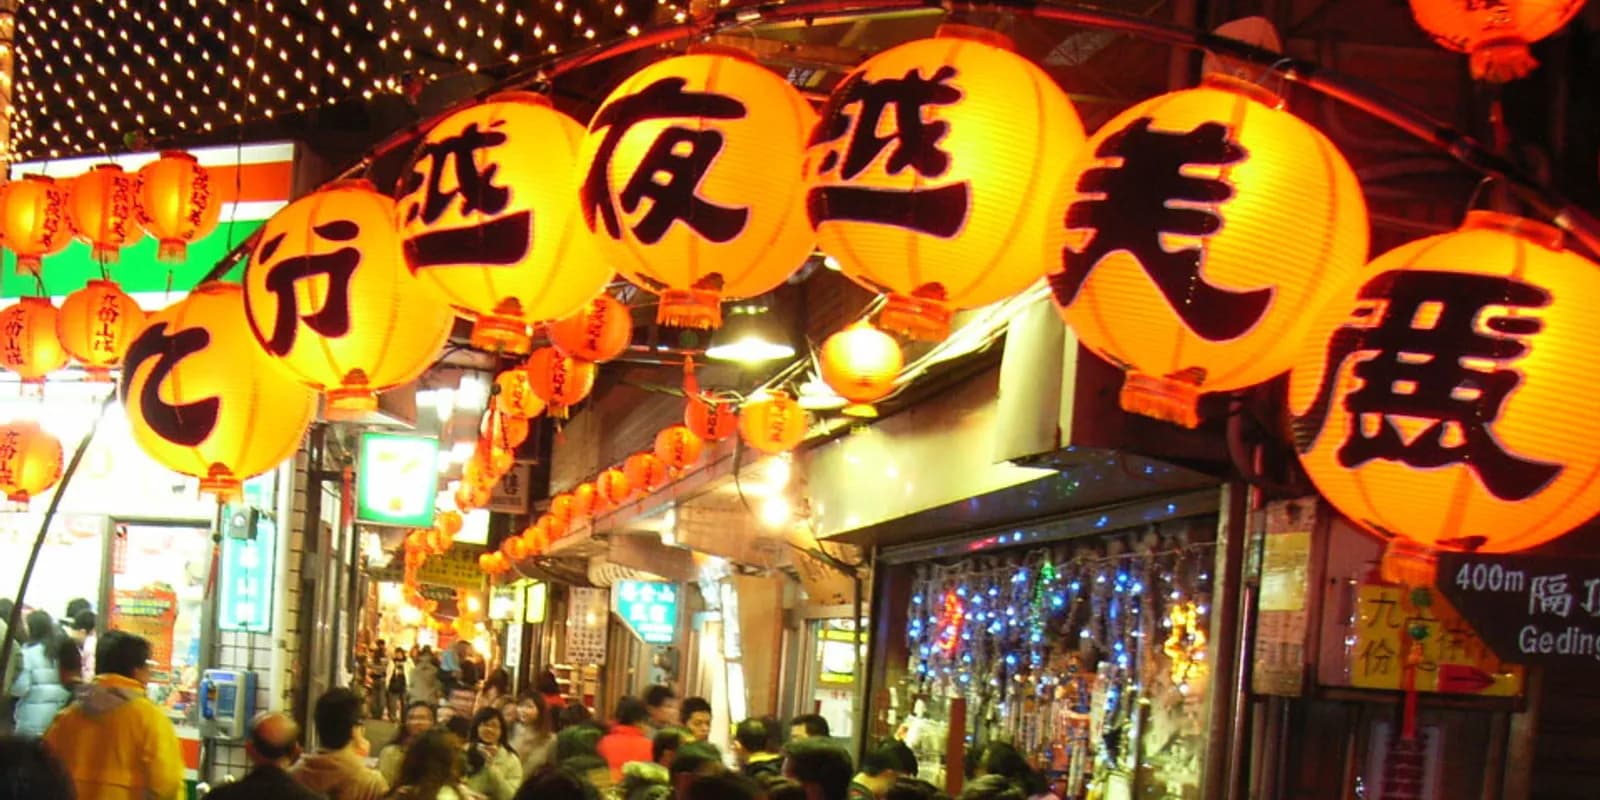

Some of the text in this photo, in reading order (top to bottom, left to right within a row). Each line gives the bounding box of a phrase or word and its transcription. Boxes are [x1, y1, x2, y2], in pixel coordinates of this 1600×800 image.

[398, 120, 535, 273] 越
[578, 77, 749, 245] 夜
[806, 65, 968, 240] 越
[1050, 117, 1276, 343] 美
[1288, 269, 1566, 502] 麗
[1455, 563, 1524, 592] 400m
